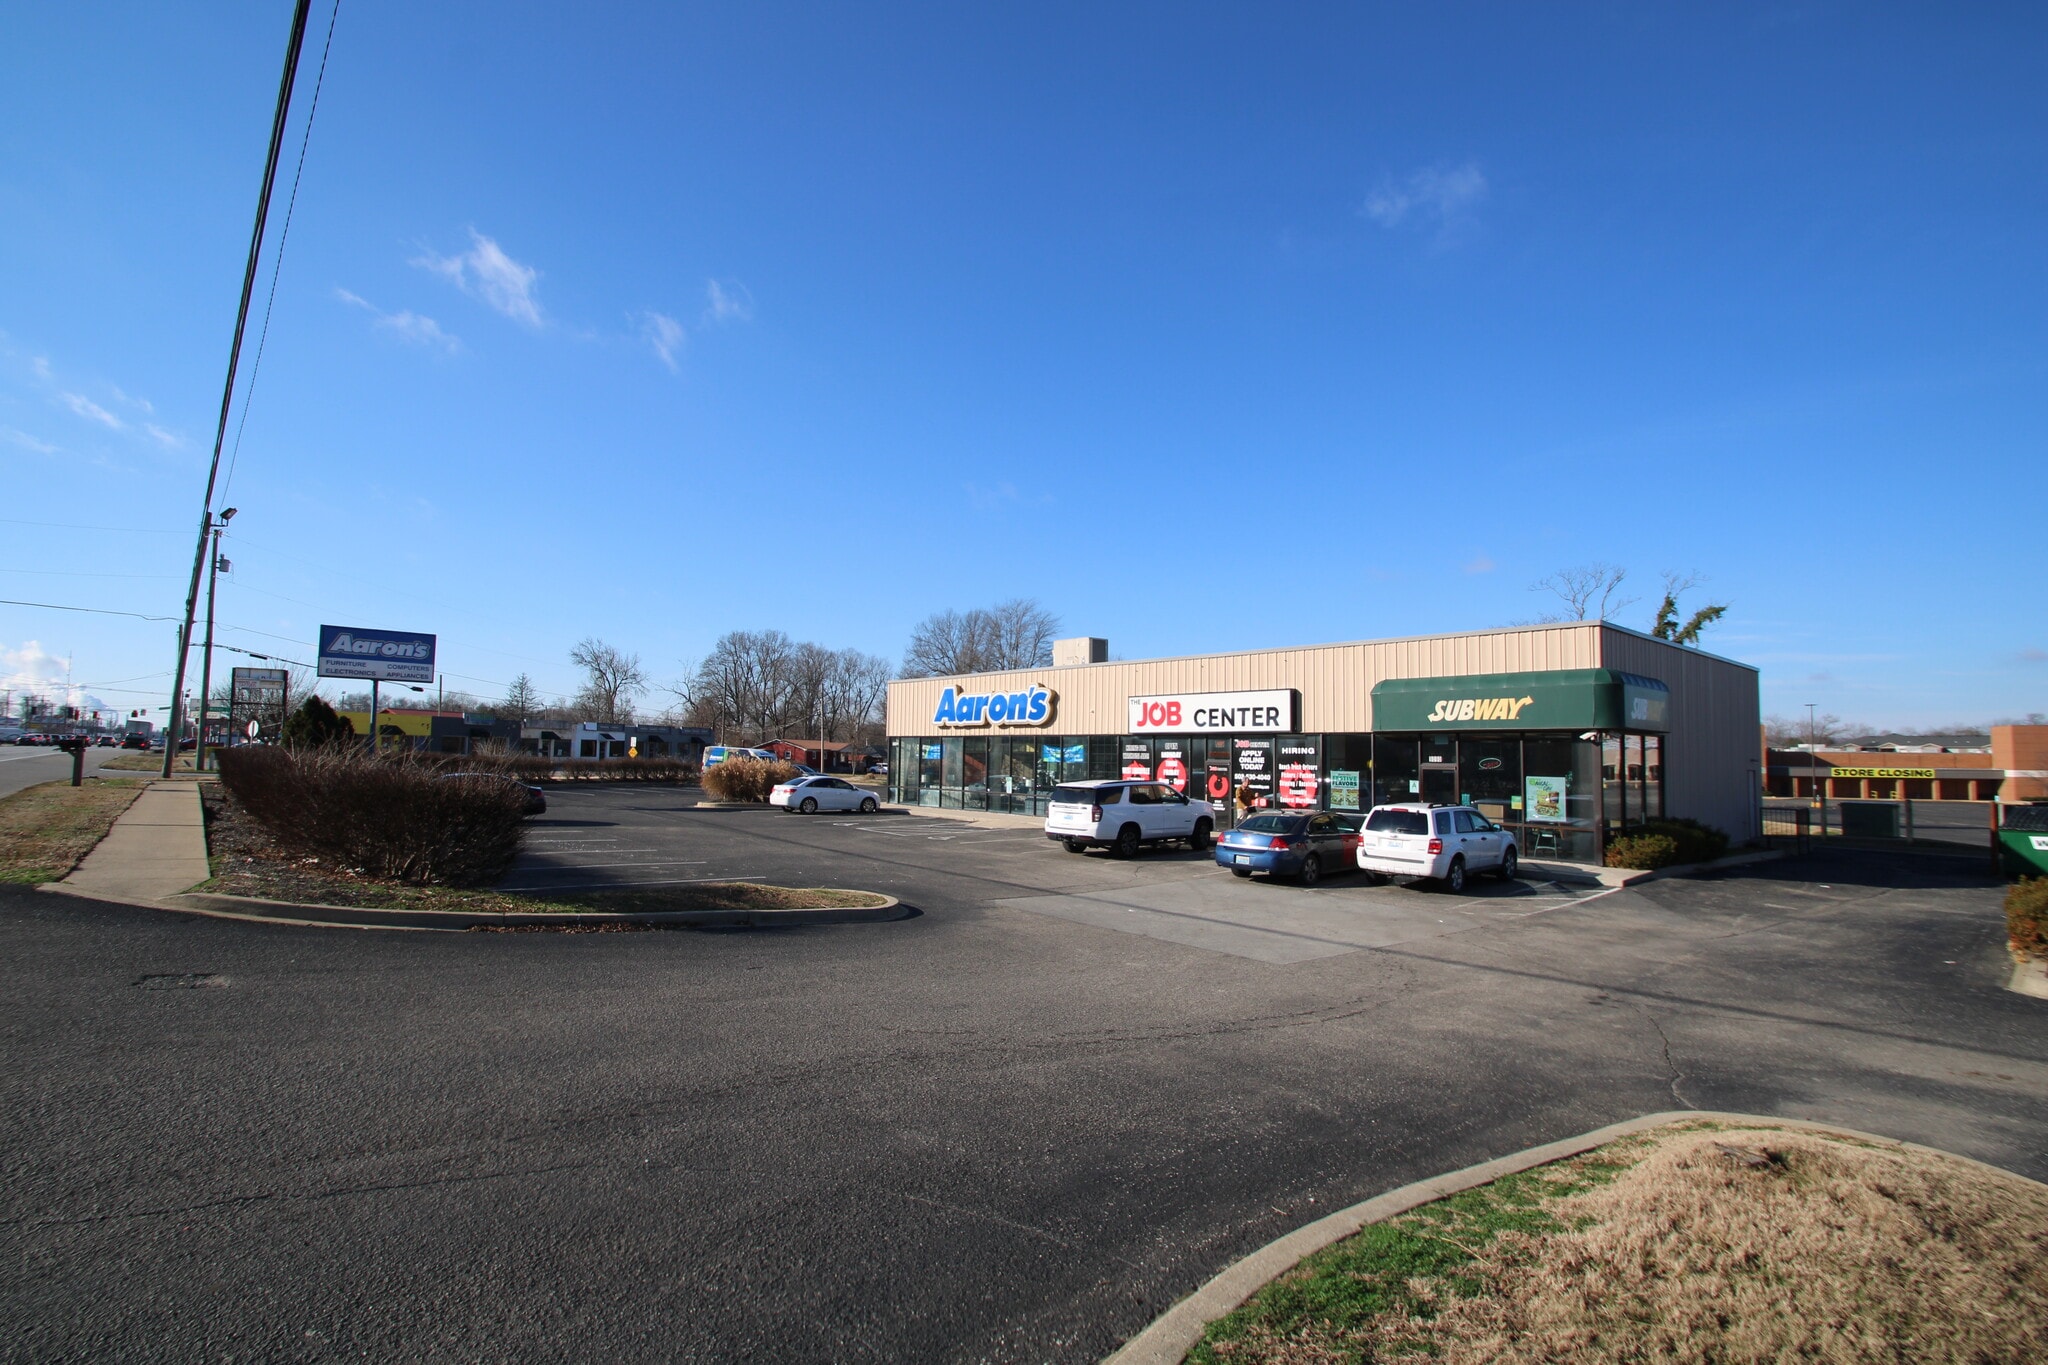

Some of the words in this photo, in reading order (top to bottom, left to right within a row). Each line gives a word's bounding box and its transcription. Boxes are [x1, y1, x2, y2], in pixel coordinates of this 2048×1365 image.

[329, 633, 429, 658] Aaron's
[325, 668, 376, 676] ELECTRONICS
[386, 672, 429, 680] APPLIANCES
[326, 660, 367, 668] FURNITURE
[387, 664, 430, 672] COMPUTERS
[933, 686, 1050, 723] Aaron's
[1427, 695, 1534, 722] SUBWAY
[1137, 701, 1182, 727] JOB
[1194, 706, 1280, 727] CENTER
[1281, 747, 1315, 755] HIRING
[1877, 769, 1933, 777] CLOSING
